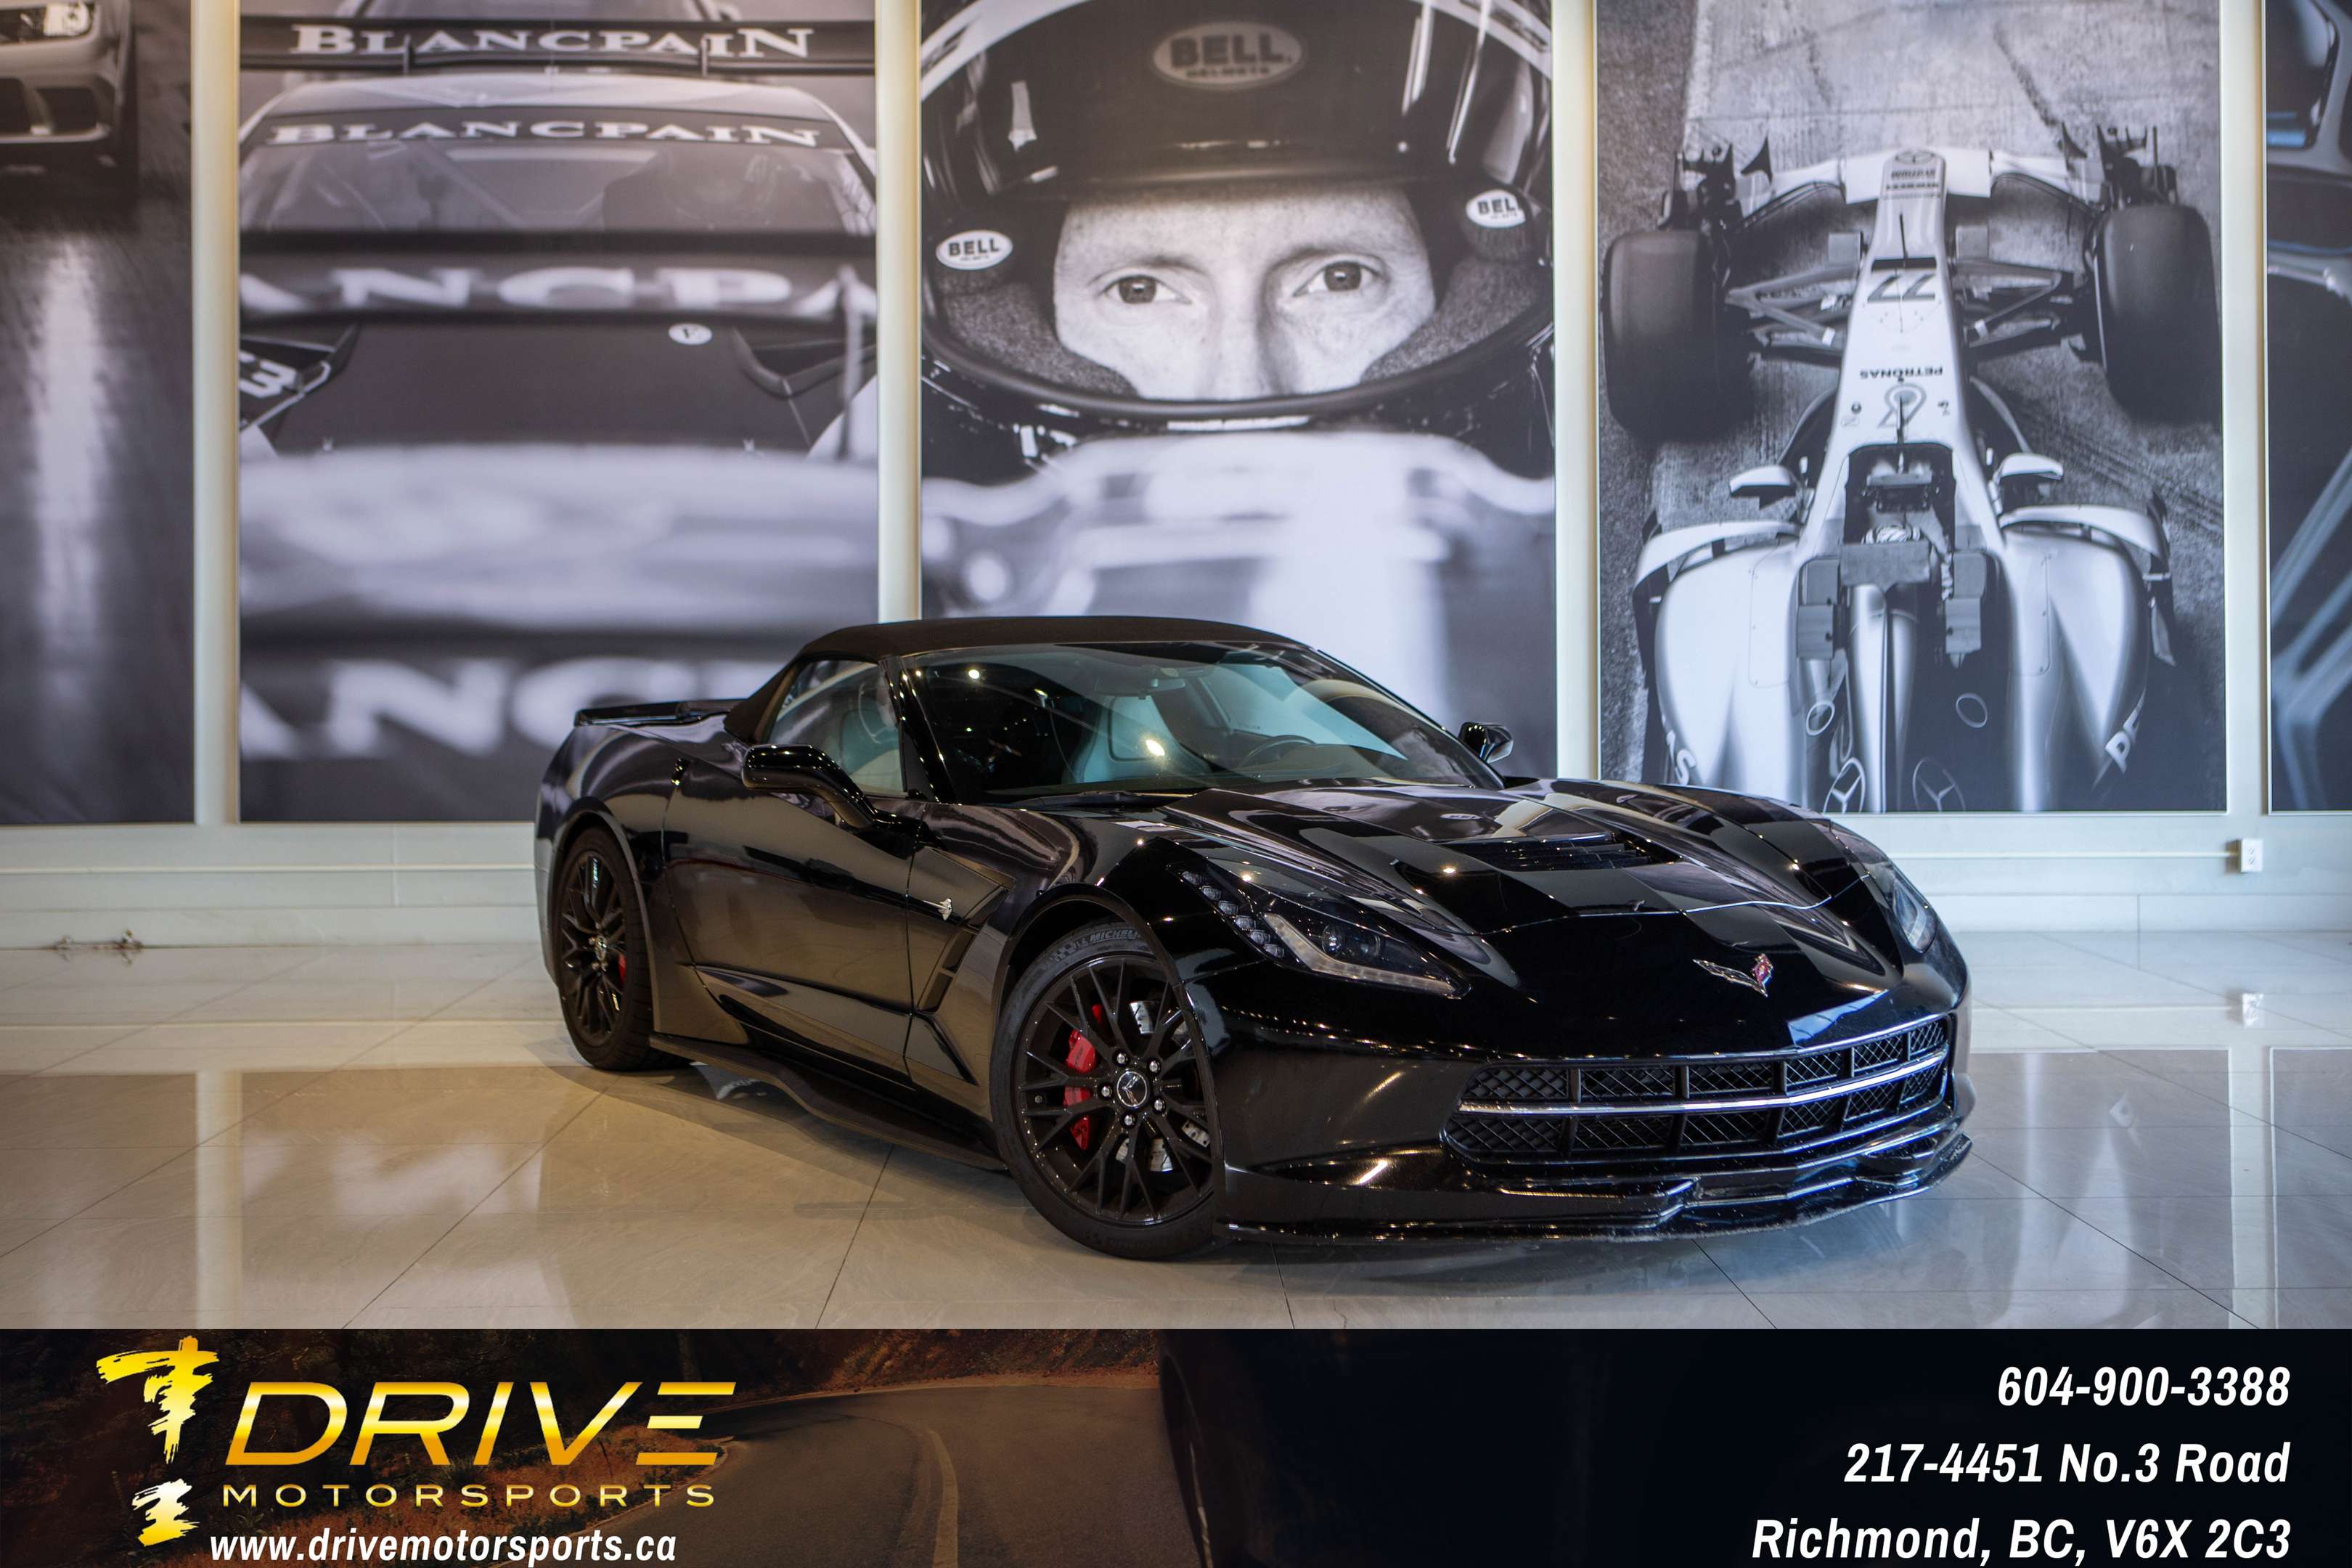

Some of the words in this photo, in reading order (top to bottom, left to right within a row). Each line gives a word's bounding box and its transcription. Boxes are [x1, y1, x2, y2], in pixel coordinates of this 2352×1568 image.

[289, 24, 814, 58] BLANCPAIN
[1169, 33, 1284, 68] BELL
[266, 121, 821, 147] BLANCPAIN
[948, 238, 1000, 257] BELL
[1860, 365, 1943, 380] PETRONAS
